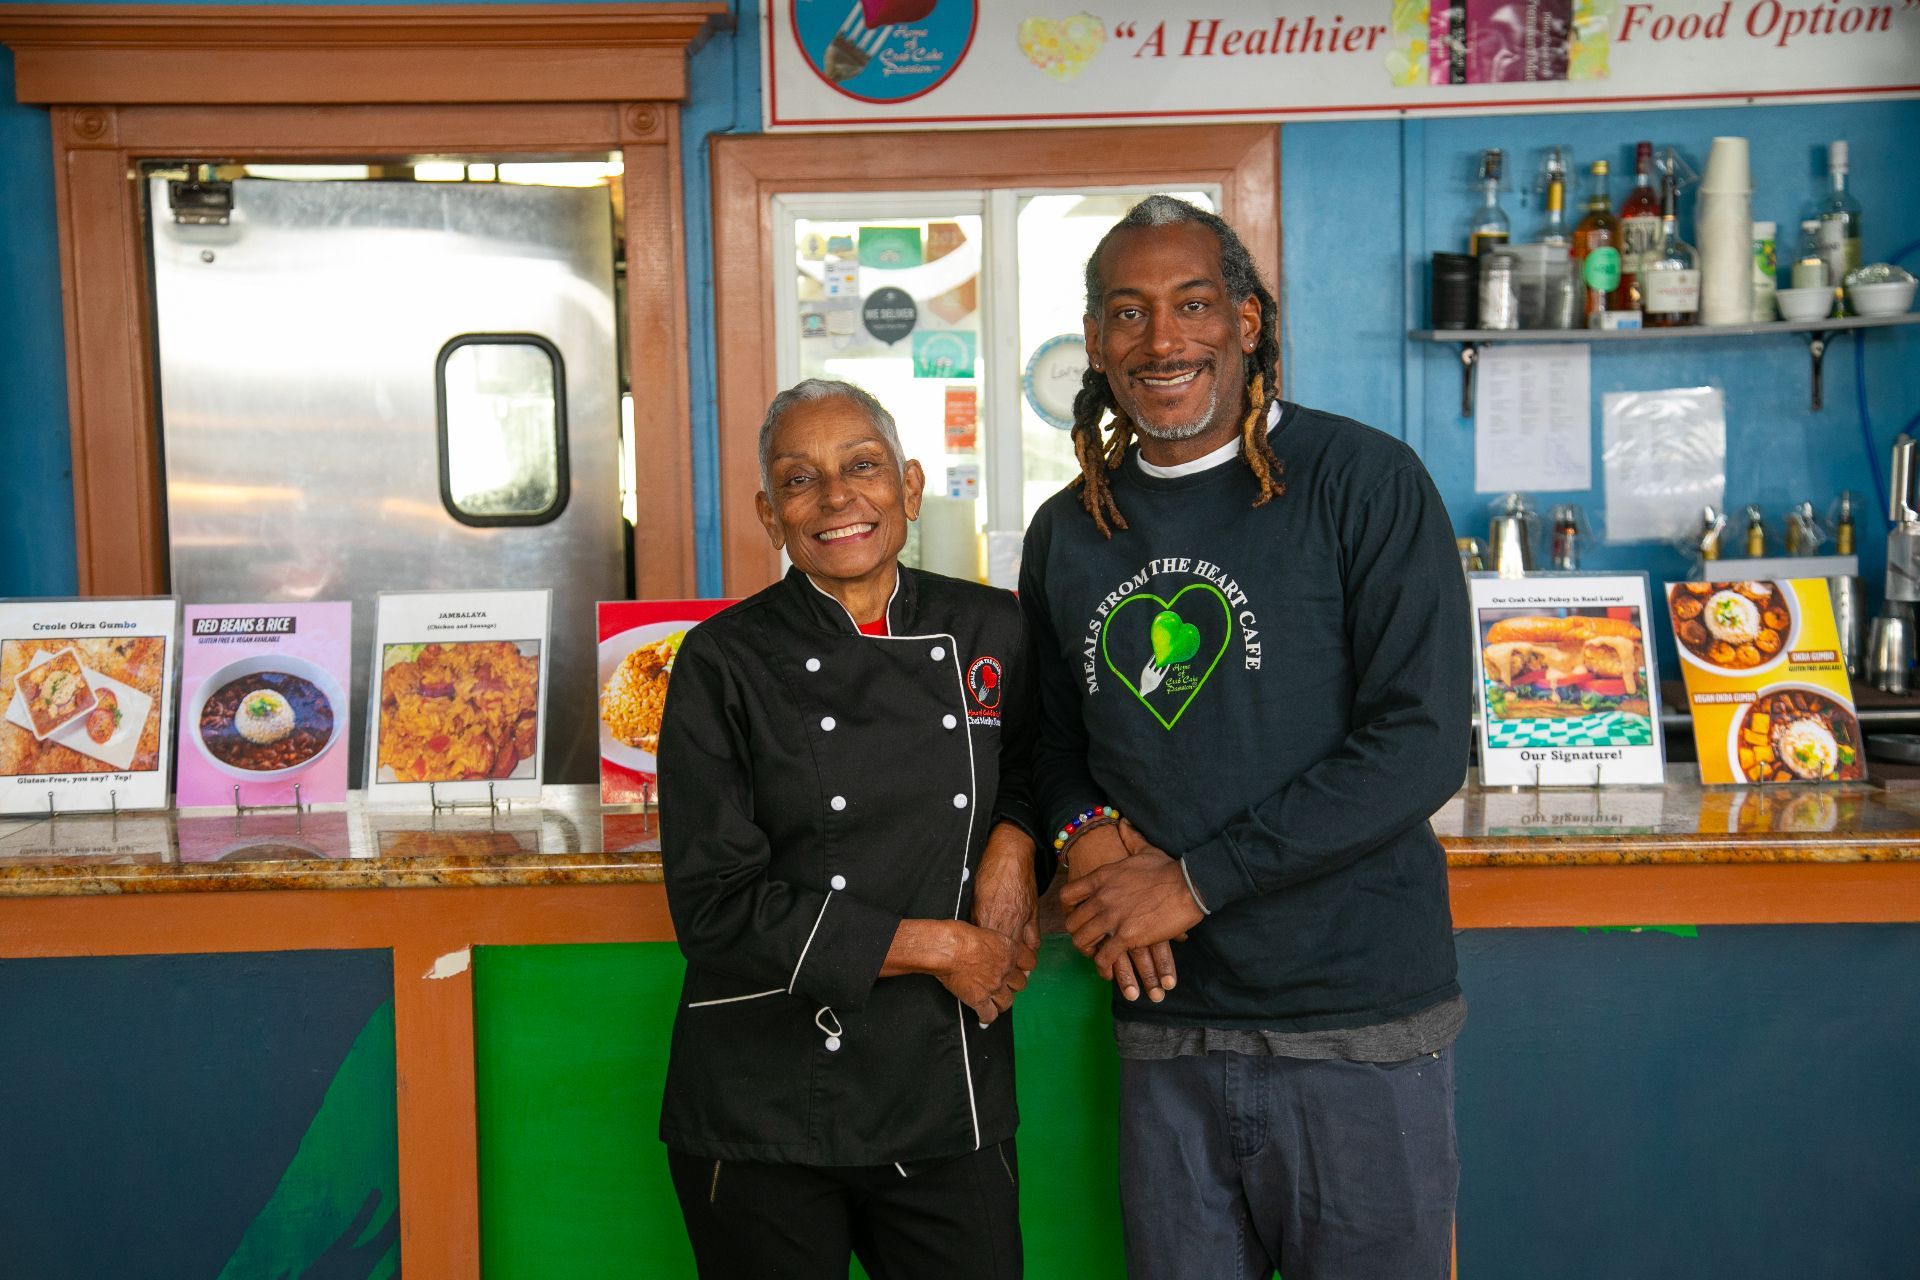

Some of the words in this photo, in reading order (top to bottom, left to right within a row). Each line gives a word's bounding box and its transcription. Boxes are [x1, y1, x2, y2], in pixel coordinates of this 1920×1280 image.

[1615, 0, 1732, 42] Food
[1179, 15, 1387, 57] Healthier
[1492, 596, 1507, 604] Our
[1600, 595, 1624, 603] Lump!
[32, 622, 67, 631] Creole
[70, 621, 96, 630] Okra
[99, 621, 137, 629] Gumbo
[196, 619, 219, 633] RED
[219, 618, 256, 633] BEANS
[255, 618, 265, 631] &
[265, 617, 291, 632] RICE
[1083, 619, 1102, 695] MEALS
[1096, 569, 1150, 618] FROM
[1149, 557, 1191, 576] THE
[1192, 559, 1249, 608] HEART
[1239, 610, 1261, 670] CAFE
[198, 637, 218, 645] GLUTEN
[1792, 652, 1810, 662] OKRA
[1811, 651, 1835, 662] GUMBO
[1693, 694, 1715, 704] VEGAN
[1716, 693, 1733, 703] OKRA
[1733, 692, 1757, 703] GUMBO
[1520, 751, 1546, 761] Our
[1551, 750, 1623, 763] Signature!
[90, 775, 109, 783] say?
[114, 774, 132, 782] Yep!
